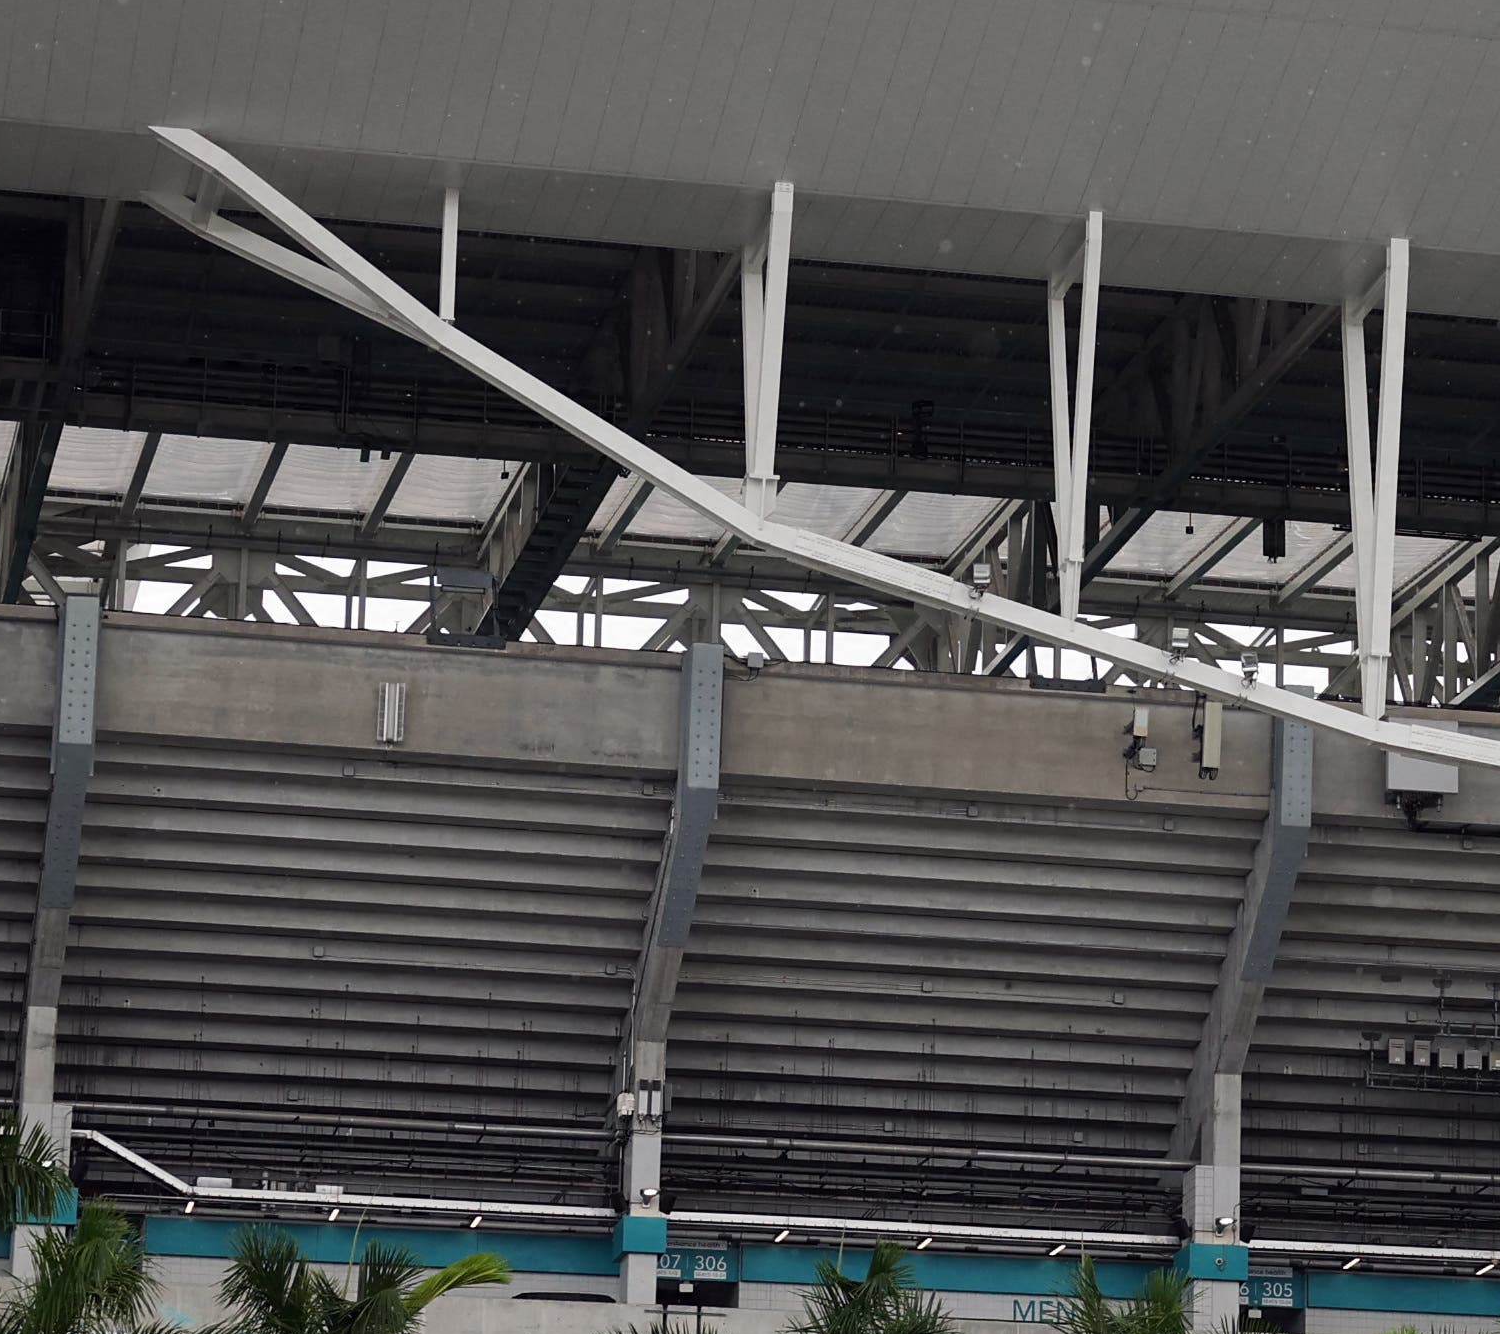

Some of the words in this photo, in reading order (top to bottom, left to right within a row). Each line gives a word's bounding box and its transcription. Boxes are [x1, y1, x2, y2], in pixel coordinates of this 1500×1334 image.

[694, 1255, 727, 1271] 306
[1262, 1282, 1293, 1298] 305
[1013, 1299, 1075, 1324] MEN
